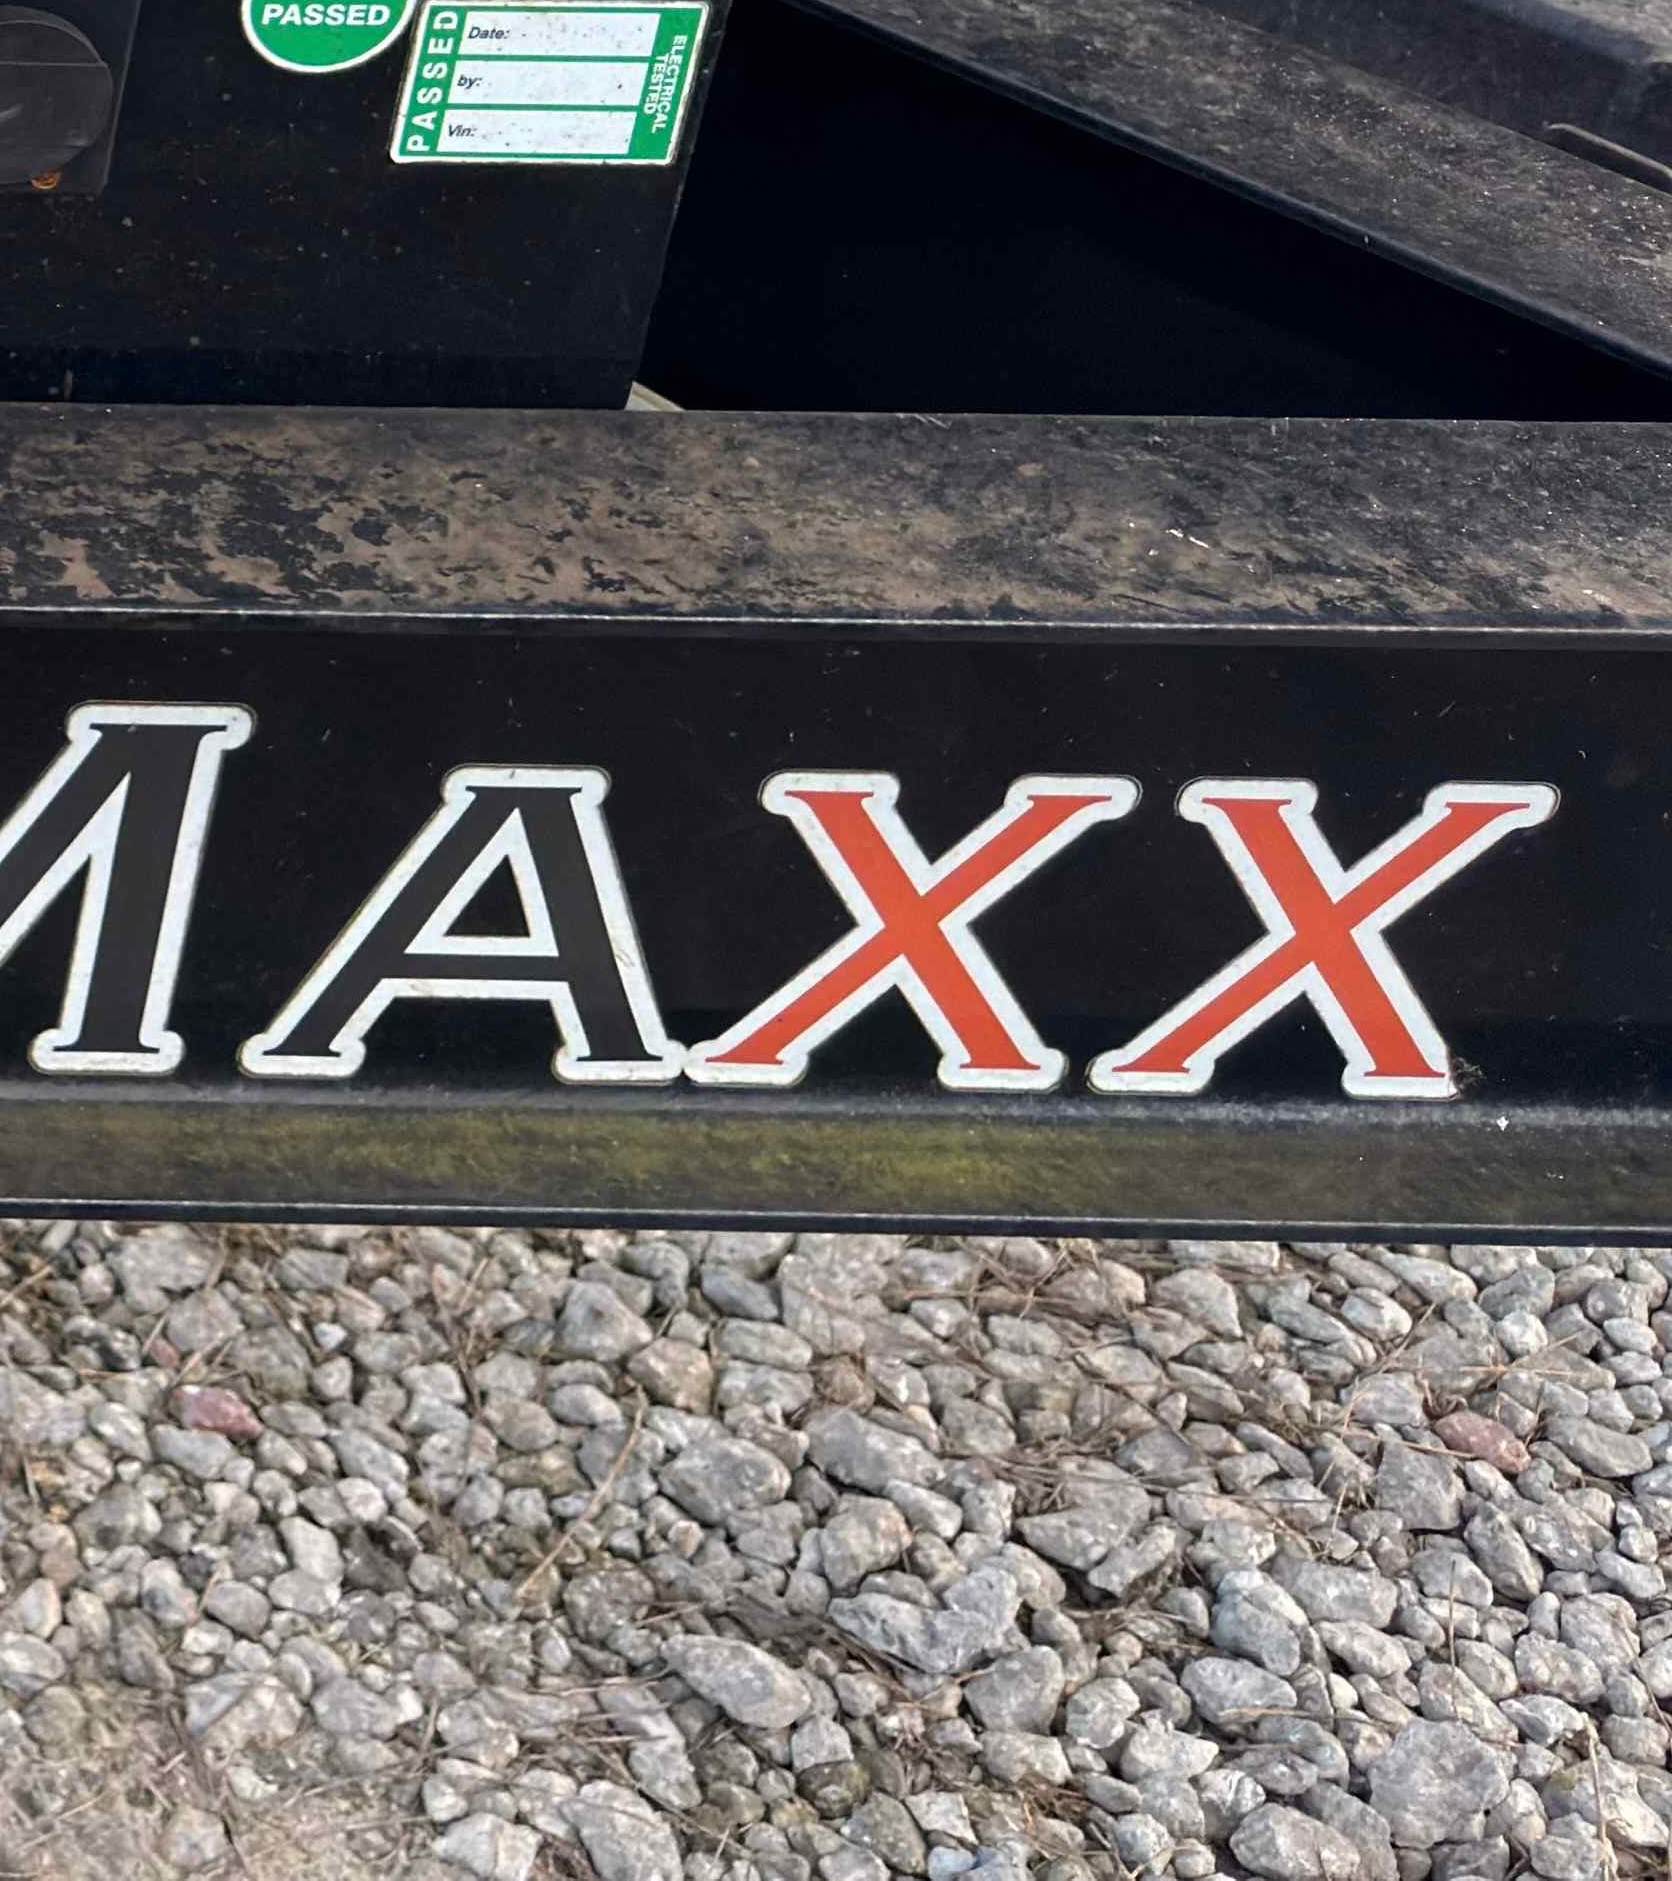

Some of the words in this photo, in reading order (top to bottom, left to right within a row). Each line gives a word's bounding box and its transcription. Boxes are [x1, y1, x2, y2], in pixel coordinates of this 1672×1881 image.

[262, 3, 391, 26] PASSED
[468, 27, 510, 40] Date:
[406, 10, 459, 152] PASSED
[457, 74, 482, 90] by:
[643, 54, 670, 115] TESTED
[651, 35, 688, 134] ELECTRICAL
[447, 125, 477, 137] Vin:
